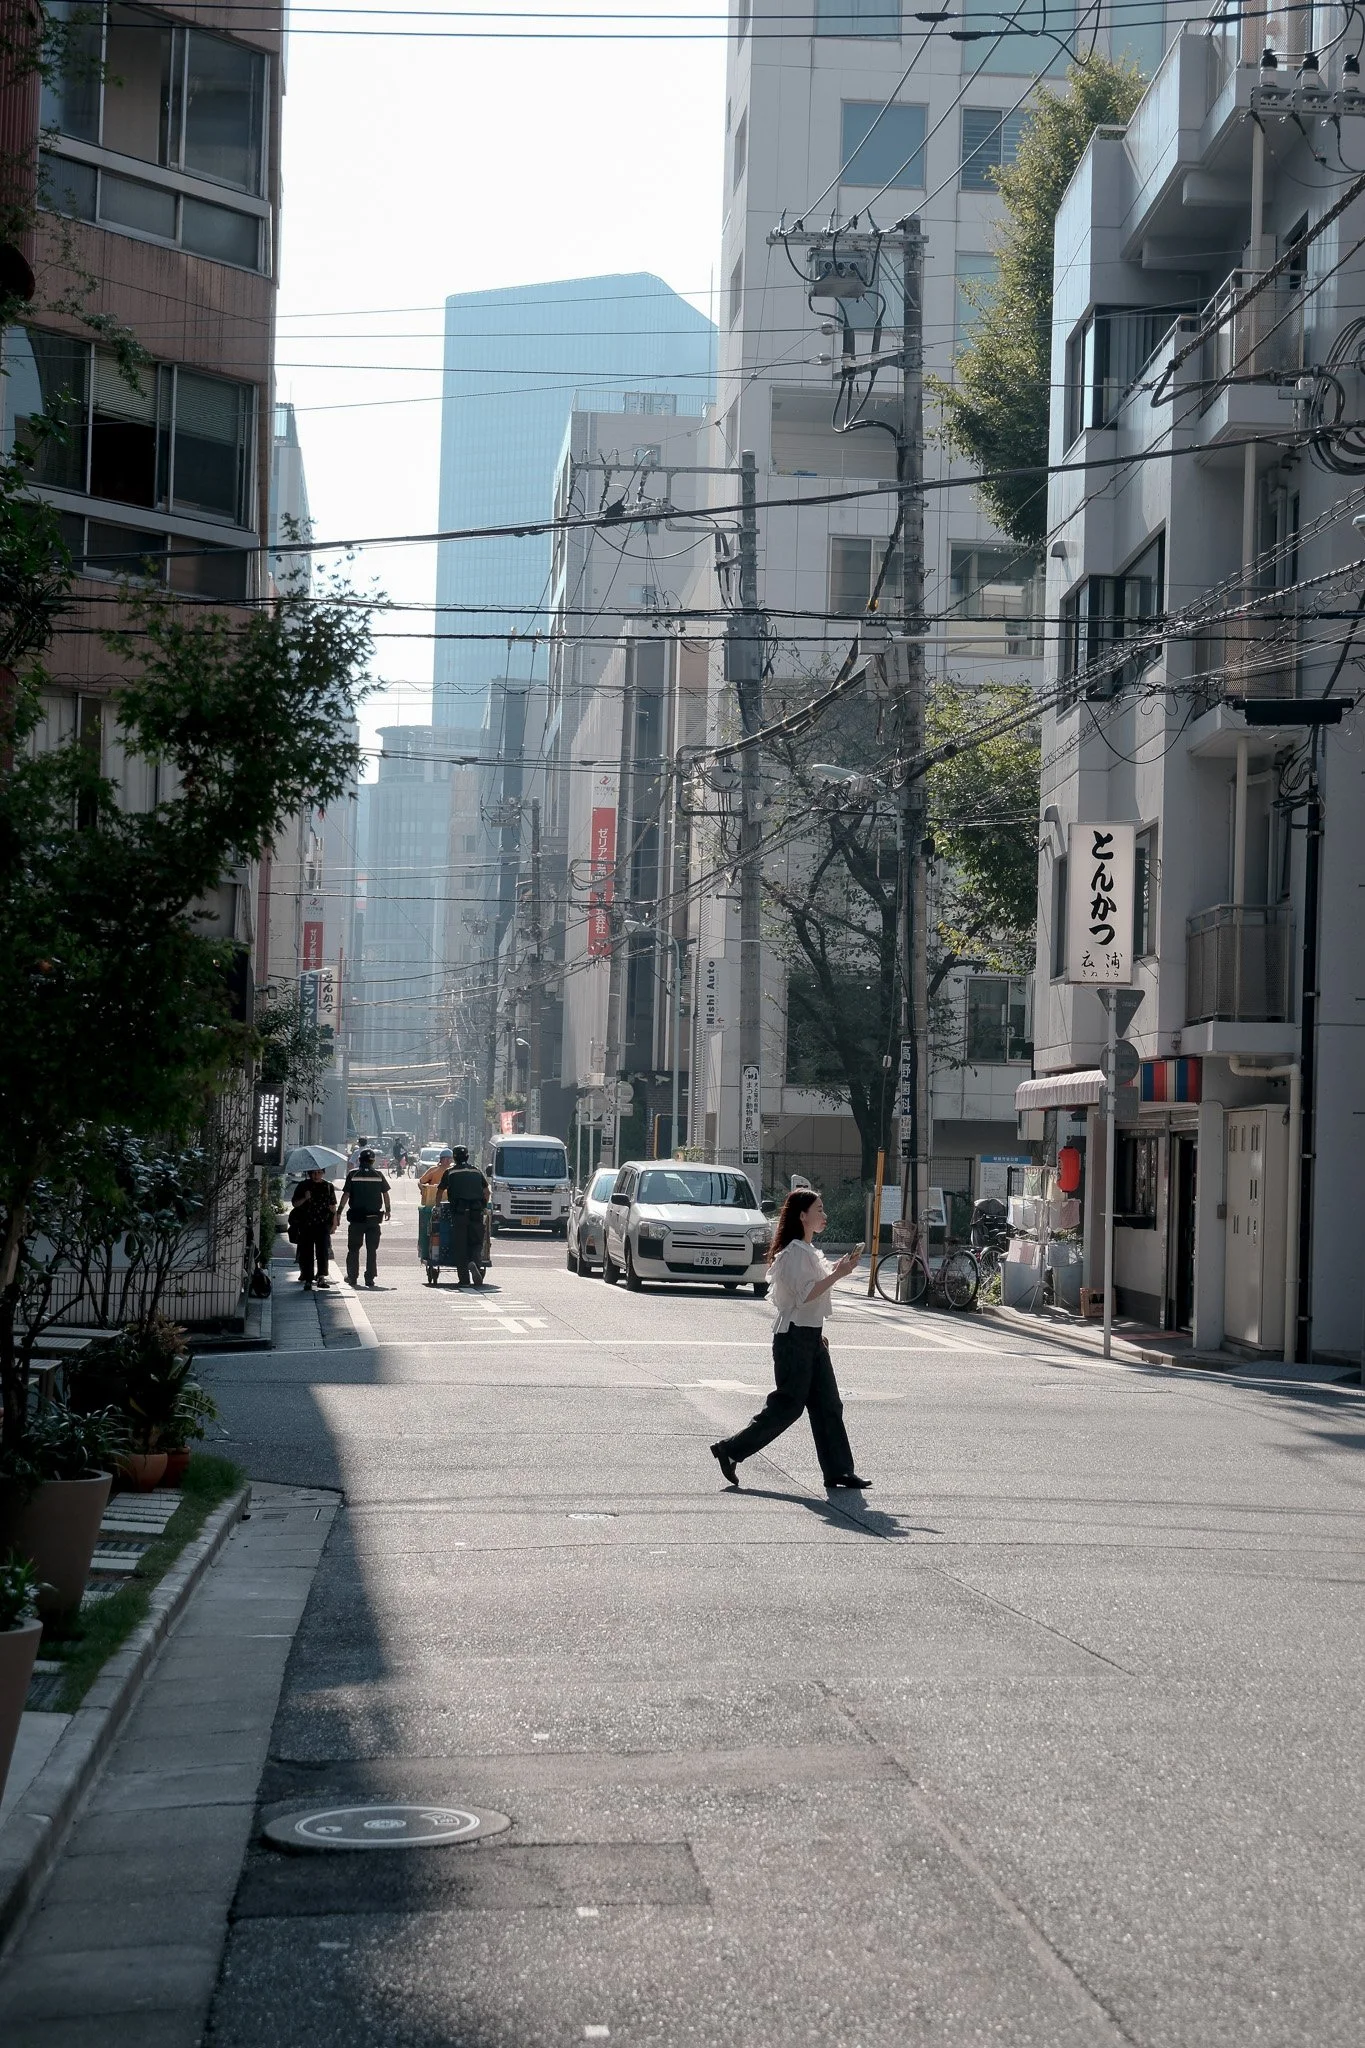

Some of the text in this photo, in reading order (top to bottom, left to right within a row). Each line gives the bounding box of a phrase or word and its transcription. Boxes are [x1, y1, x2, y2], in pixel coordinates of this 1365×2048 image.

[1089, 830, 1118, 946] とんかつ
[1081, 950, 1123, 970] 衣浦
[706, 961, 715, 990] Auto
[706, 995, 715, 1025] Nishi
[745, 1081, 754, 1131] まつき動物病院
